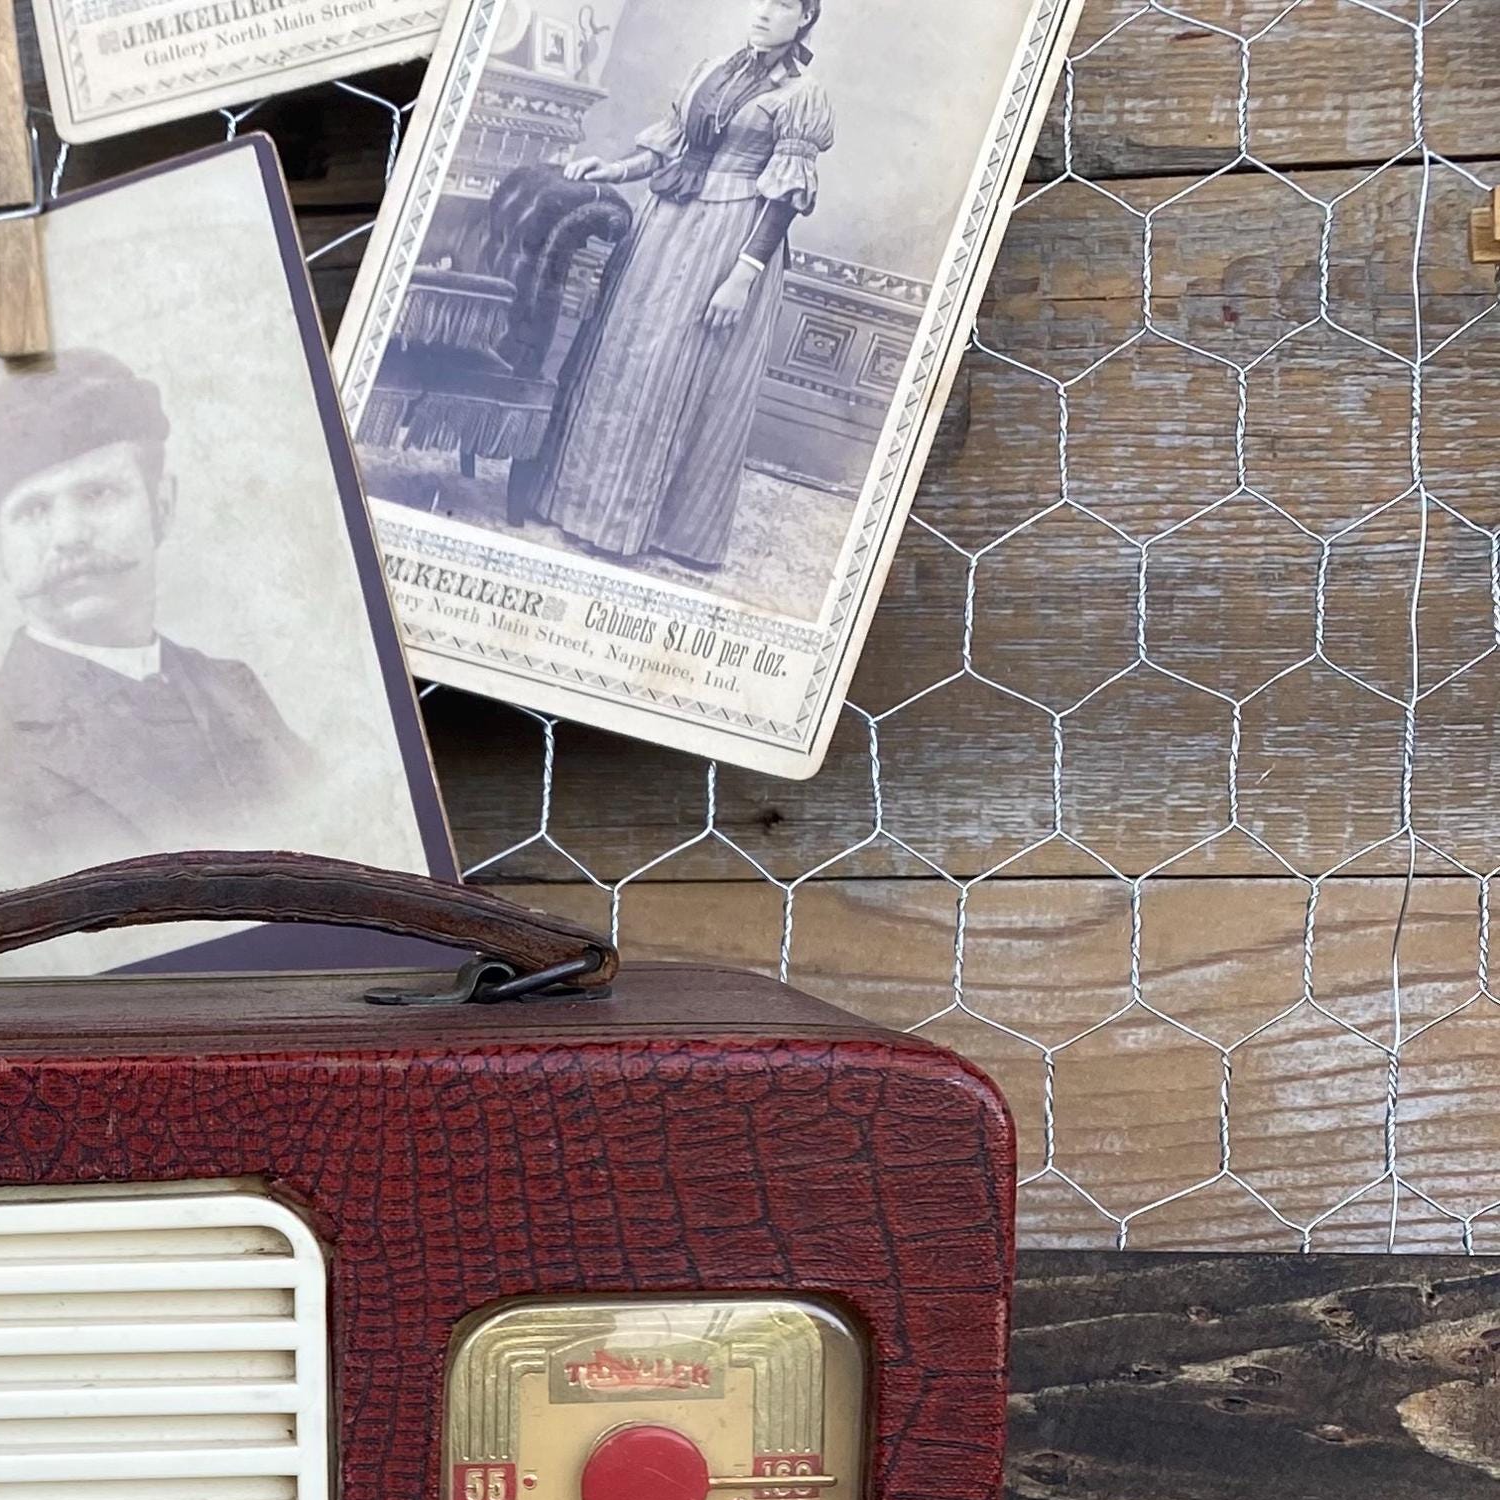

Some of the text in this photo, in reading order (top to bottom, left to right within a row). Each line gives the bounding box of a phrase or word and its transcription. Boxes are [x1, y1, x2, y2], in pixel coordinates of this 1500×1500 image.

[143, 39, 208, 66] Gallery
[214, 21, 267, 50] North
[273, 12, 316, 35] Main
[427, 596, 481, 625] North
[487, 610, 530, 637] Main
[534, 624, 595, 657] Street,
[584, 600, 788, 678] Cabinets $1.00 per doz.
